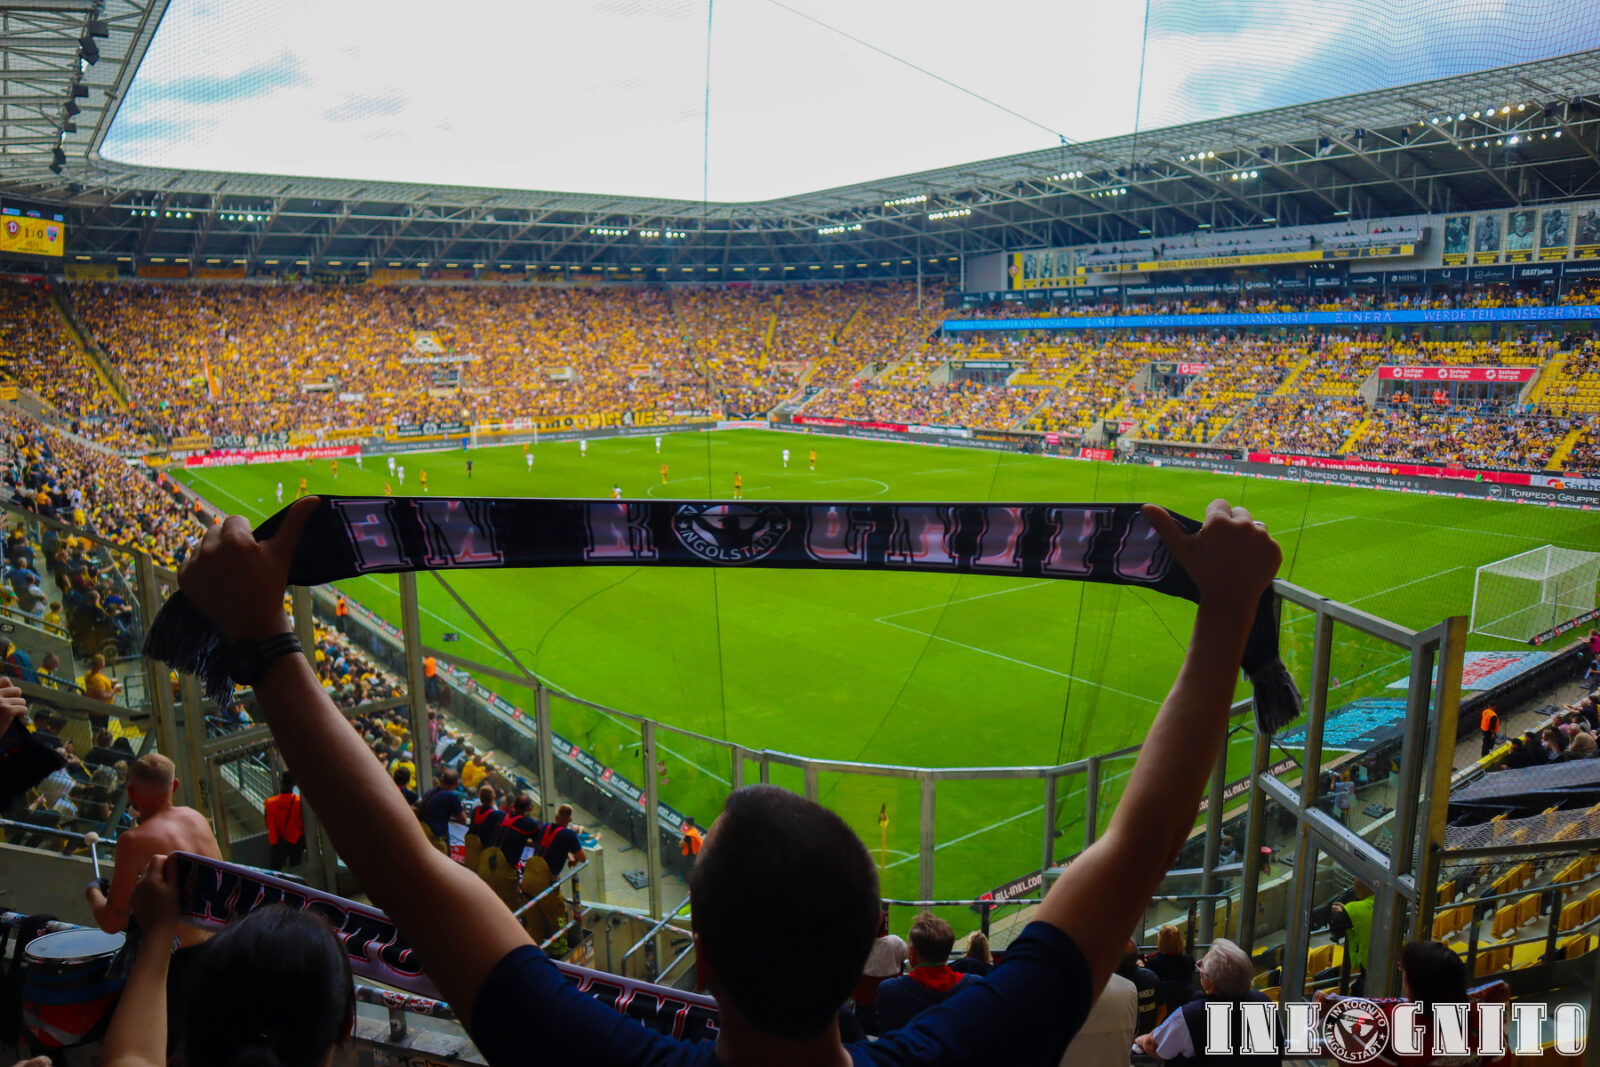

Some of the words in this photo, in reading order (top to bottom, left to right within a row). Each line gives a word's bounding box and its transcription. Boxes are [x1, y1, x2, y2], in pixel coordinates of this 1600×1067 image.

[1424, 310, 1469, 320] WERDE
[1470, 309, 1497, 319] TEIL
[1502, 308, 1564, 319] UNSERER
[1302, 469, 1338, 480] TORPEDO
[1339, 472, 1371, 484] GRUPPE
[1376, 477, 1388, 485] Wir
[1510, 488, 1555, 500] TORPEDO
[1557, 493, 1600, 504] GRUPPE
[679, 528, 780, 560] INGOLSTADT
